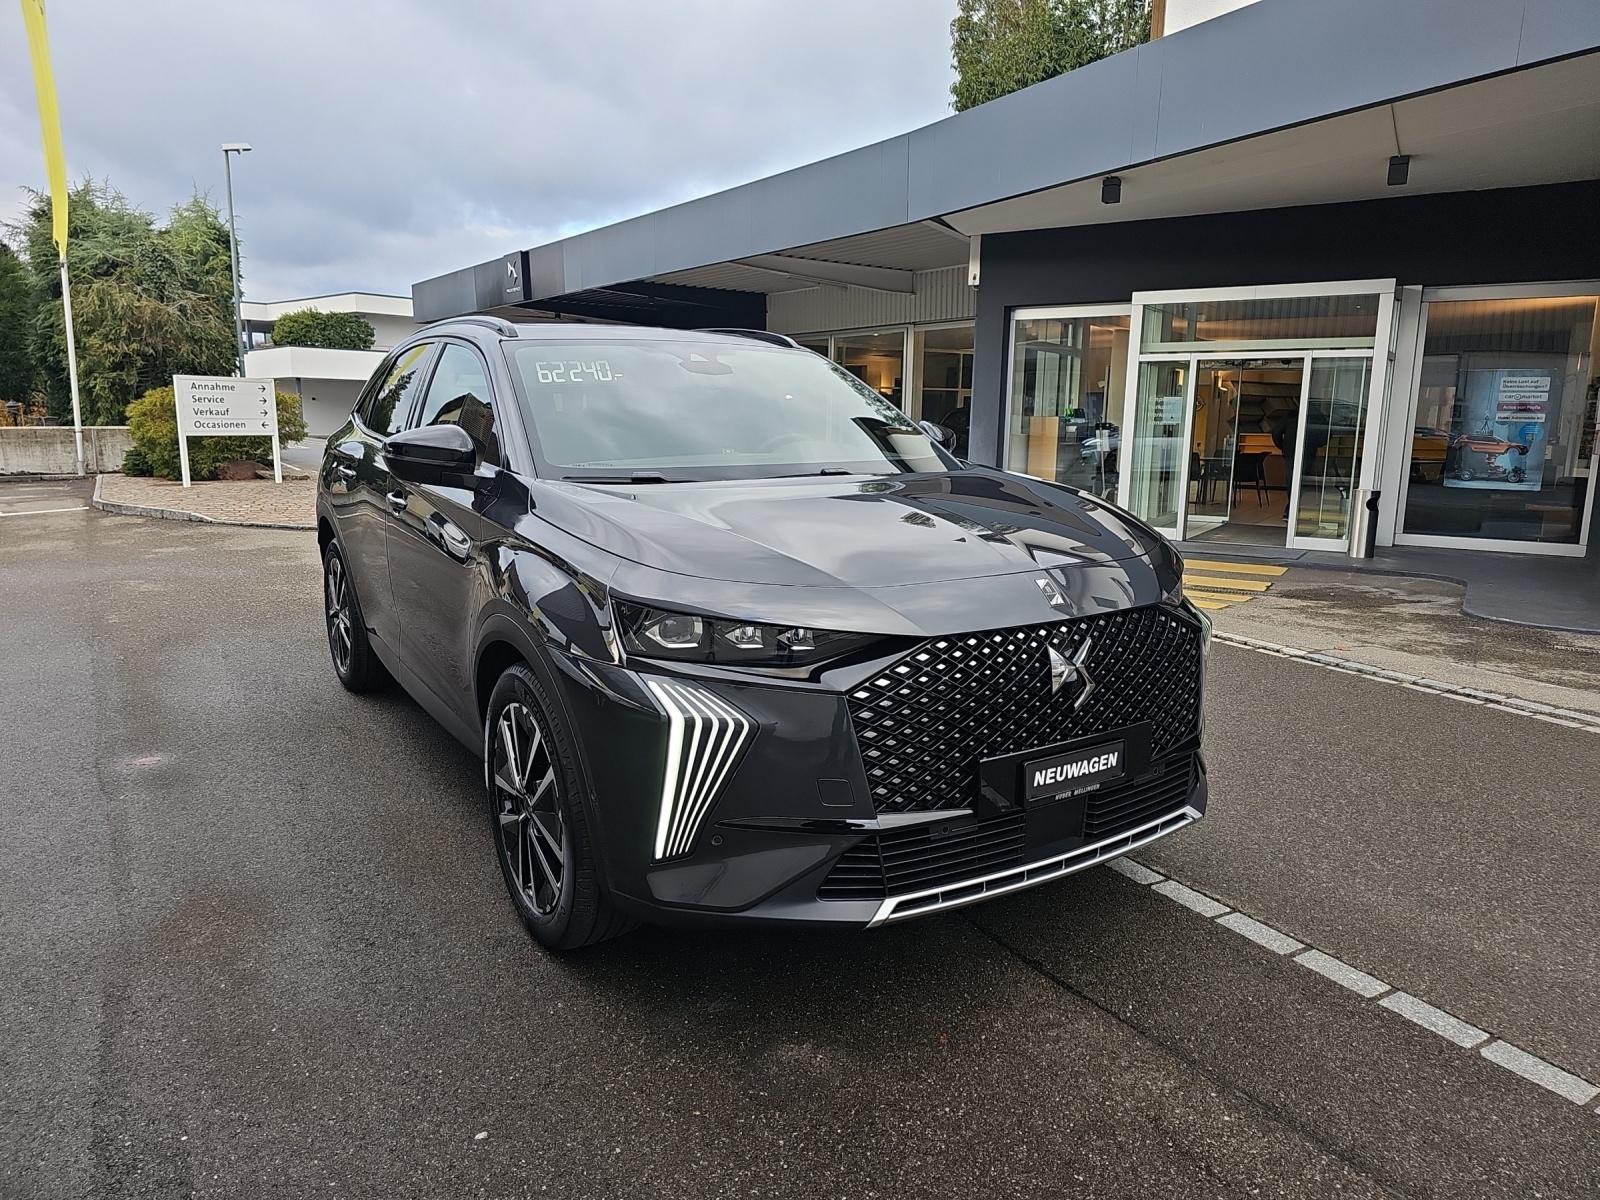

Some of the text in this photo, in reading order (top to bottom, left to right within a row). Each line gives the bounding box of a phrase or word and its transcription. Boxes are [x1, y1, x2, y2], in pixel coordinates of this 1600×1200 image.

[190, 382, 236, 392] Annahme
[191, 395, 225, 404] Service
[193, 407, 230, 416] Verkauf
[193, 420, 246, 429] Occasionen
[1033, 751, 1119, 787] NEUWAGEN
